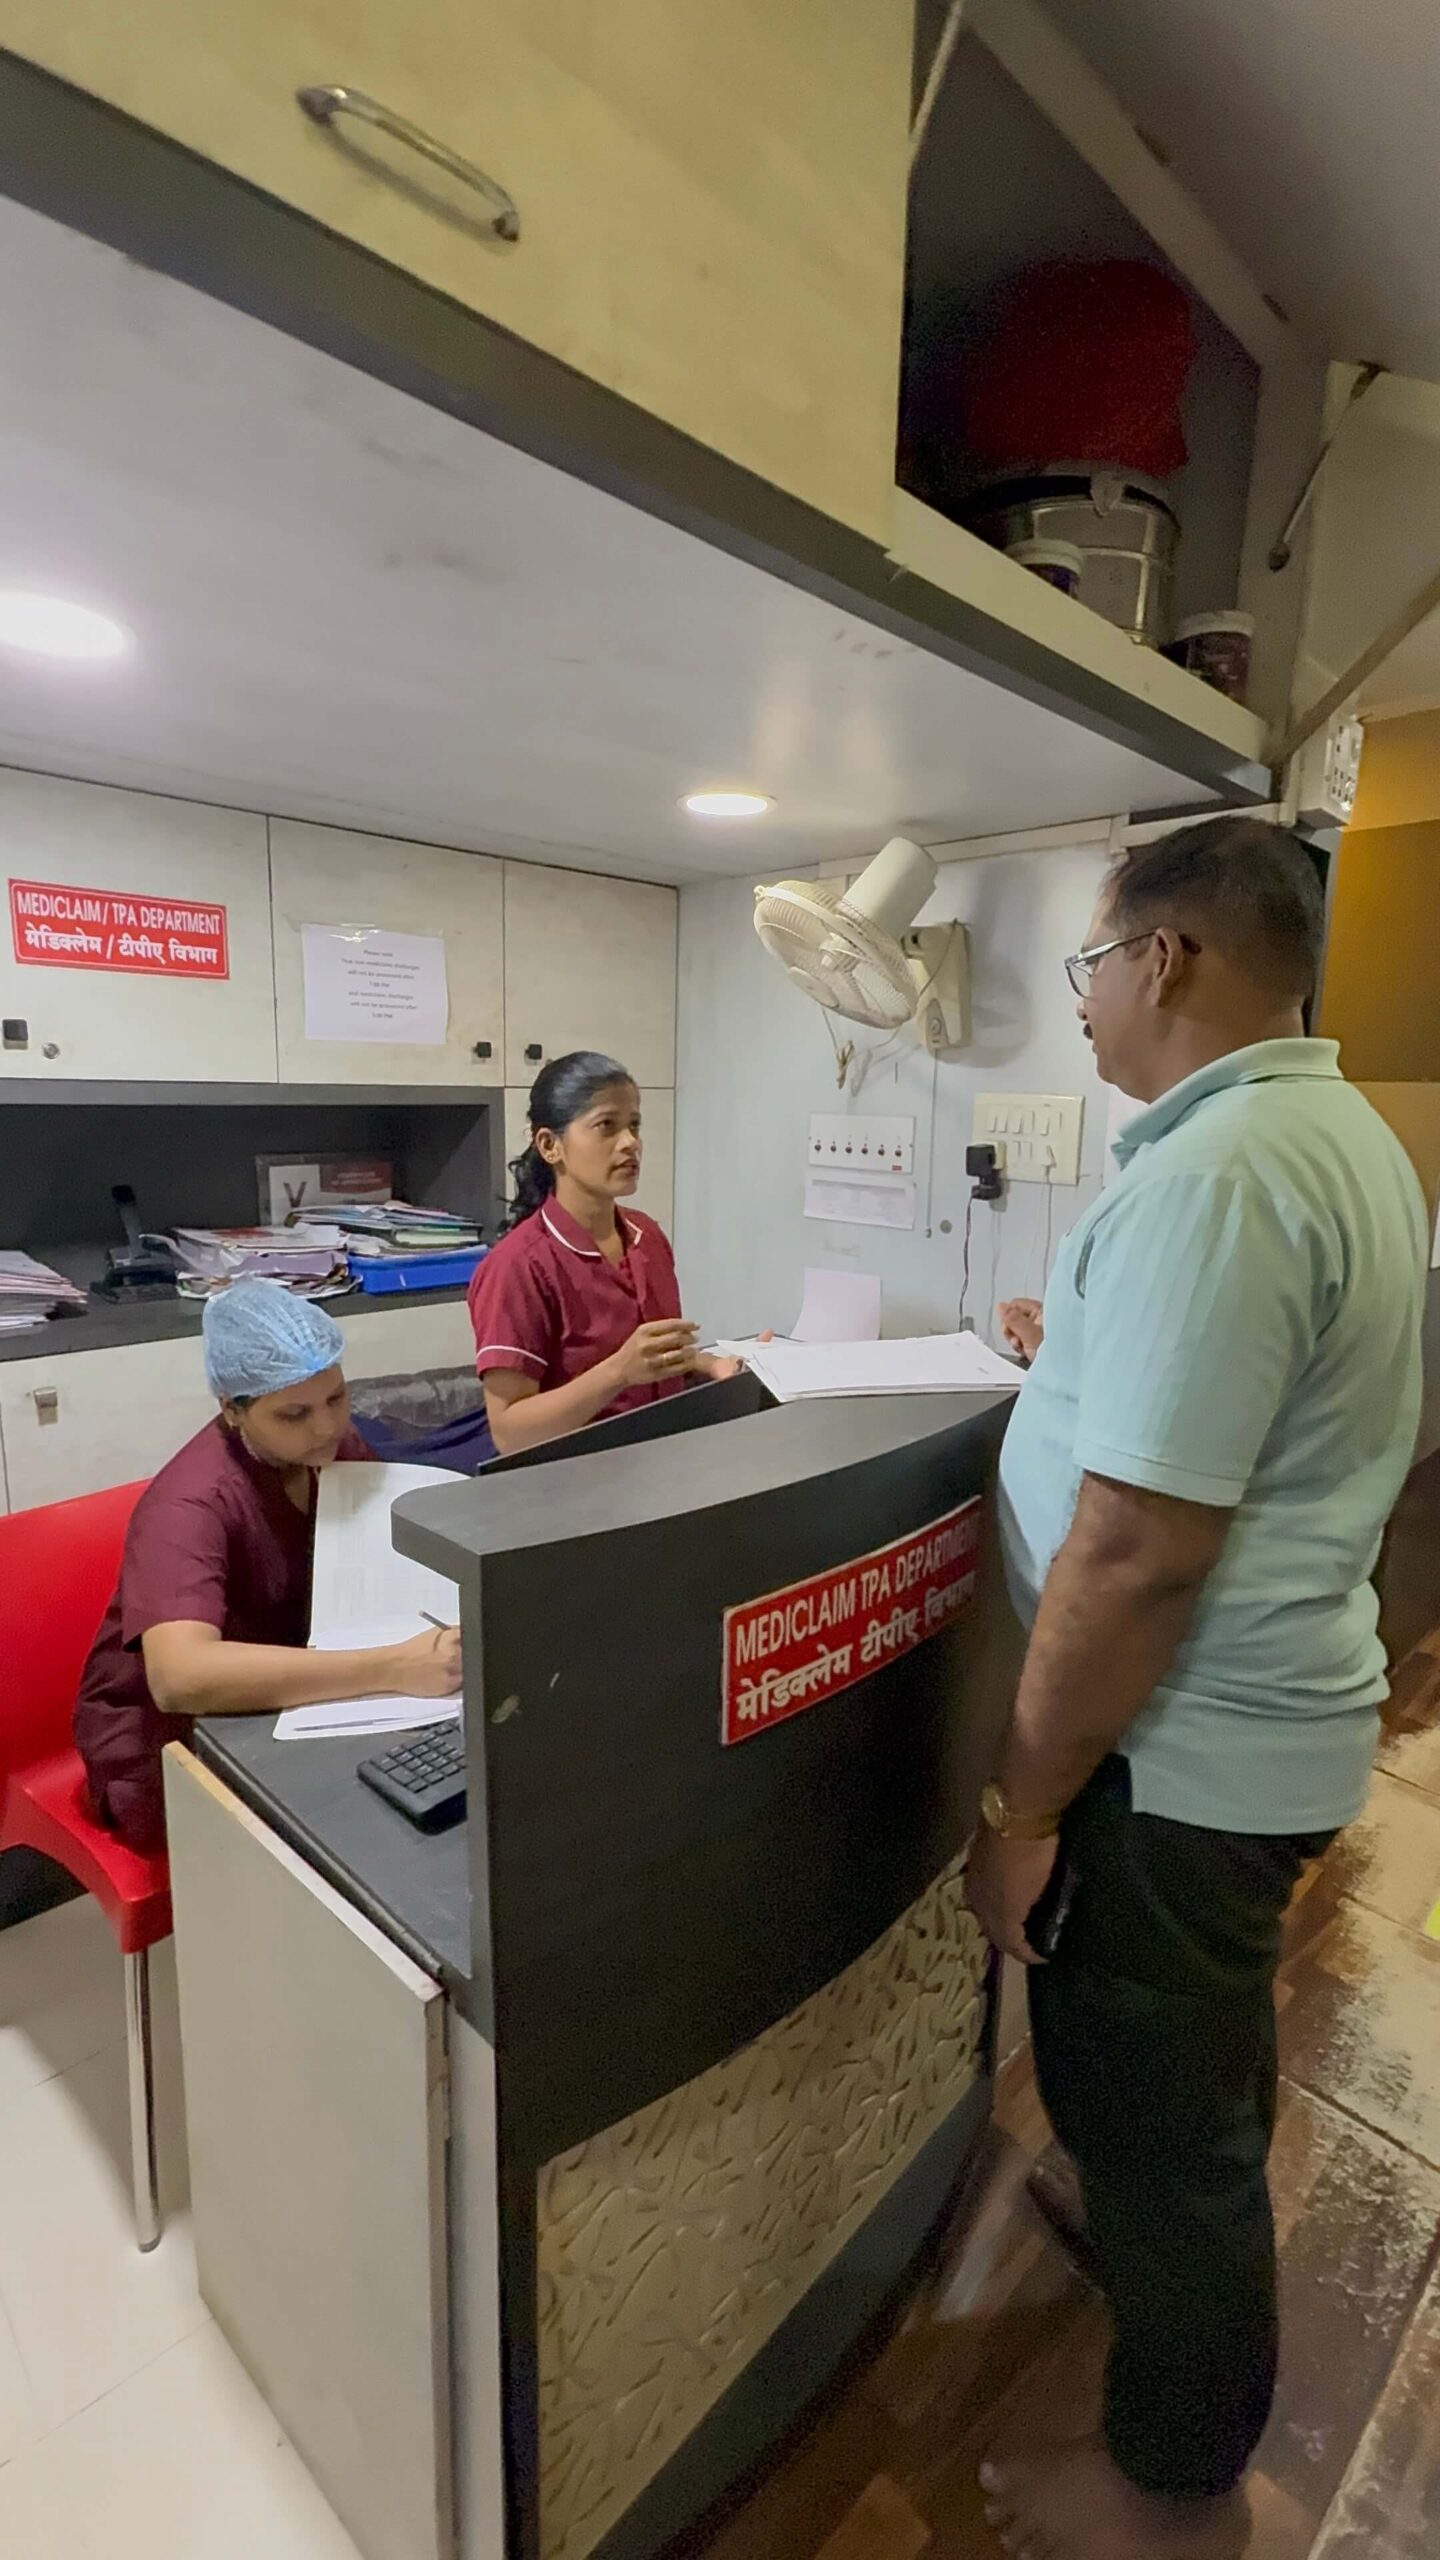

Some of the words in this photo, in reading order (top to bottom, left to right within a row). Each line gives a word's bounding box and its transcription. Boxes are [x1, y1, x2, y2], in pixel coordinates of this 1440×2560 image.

[24, 921, 102, 954] मेडिक्लेम
[117, 932, 167, 964] टीपीए
[168, 937, 218, 964] विभाग
[112, 902, 138, 926] TPA
[140, 906, 220, 935] DEPARTMENT
[735, 1577, 857, 1667] MEDICLAIM
[860, 1563, 891, 1611] TPA
[736, 1643, 854, 1721] मेडिक्लेम
[859, 1606, 921, 1664] टीपीए
